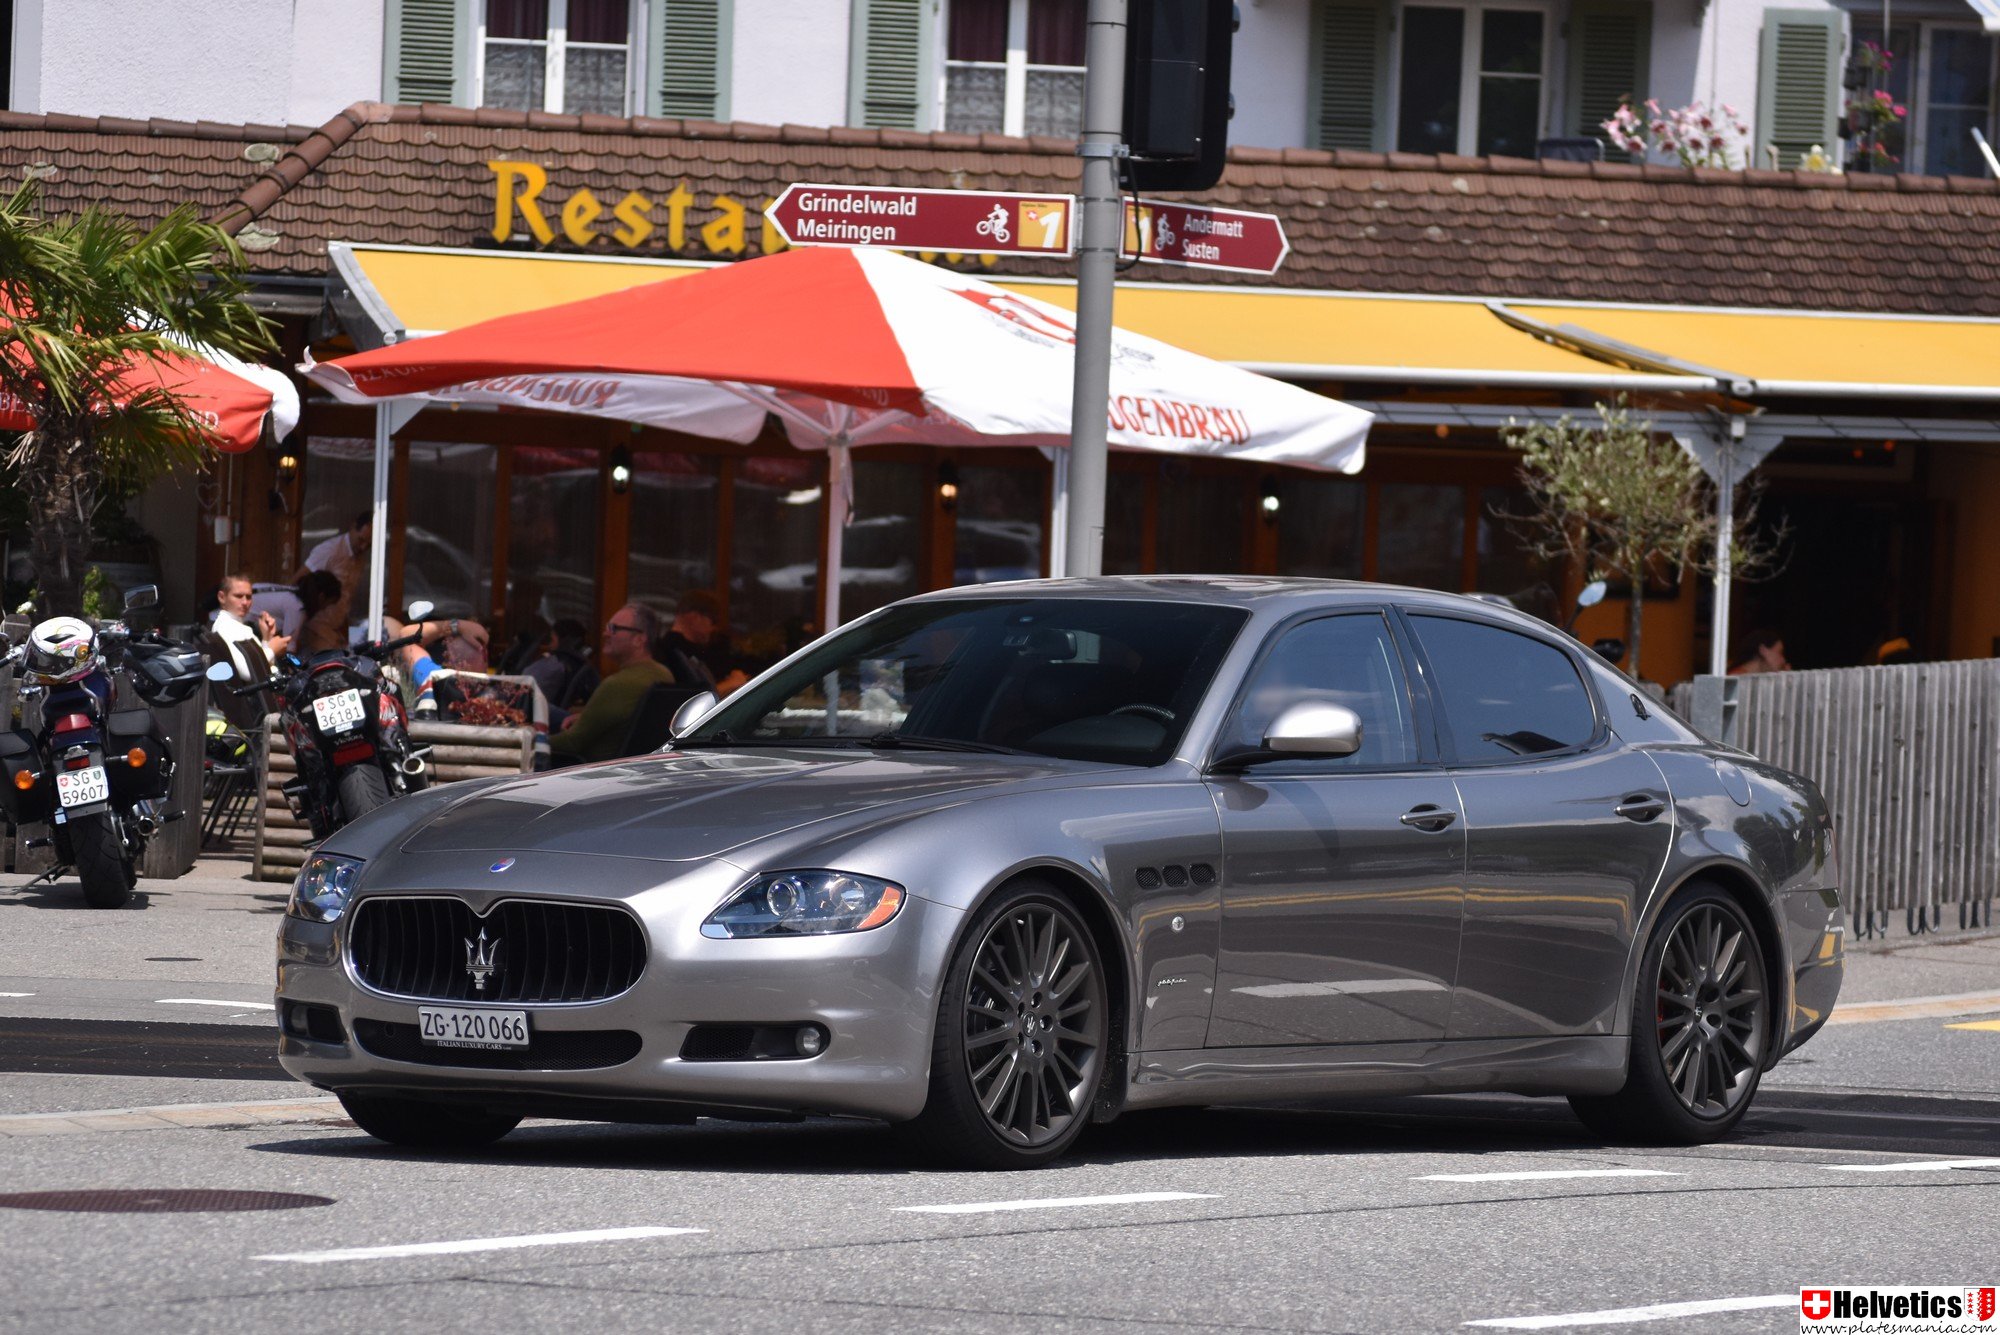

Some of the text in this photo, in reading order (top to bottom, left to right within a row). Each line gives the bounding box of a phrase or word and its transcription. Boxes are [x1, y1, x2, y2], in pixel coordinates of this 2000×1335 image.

[798, 193, 917, 216] Grindelwald
[797, 218, 896, 244] Meiringen
[1040, 211, 1061, 249] 1
[1184, 214, 1244, 238] Andermatt
[1182, 239, 1220, 260] Susten
[1108, 395, 1251, 446] UGENBRÄU
[328, 695, 346, 709] SG
[321, 706, 361, 728] 36181
[72, 772, 90, 786] SG
[62, 784, 104, 805] 59607
[489, 1016, 525, 1041] 066
[437, 1040, 461, 1048] ITALIAN
